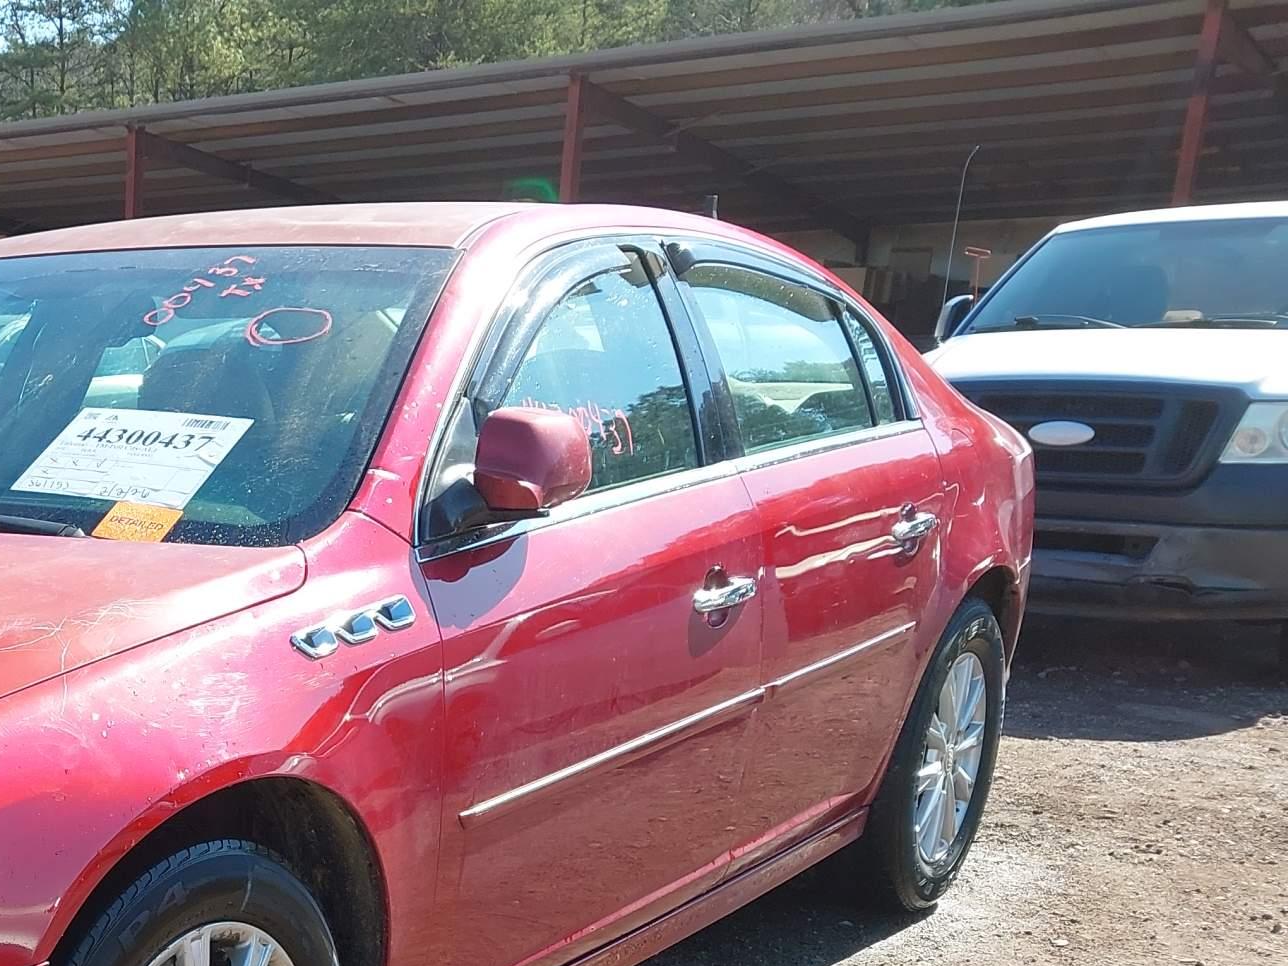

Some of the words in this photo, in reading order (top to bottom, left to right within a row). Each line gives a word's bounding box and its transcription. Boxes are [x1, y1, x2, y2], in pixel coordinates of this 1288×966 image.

[143, 255, 257, 326] 00437
[76, 426, 216, 453] 44300437
[108, 515, 164, 532] DETAILED
